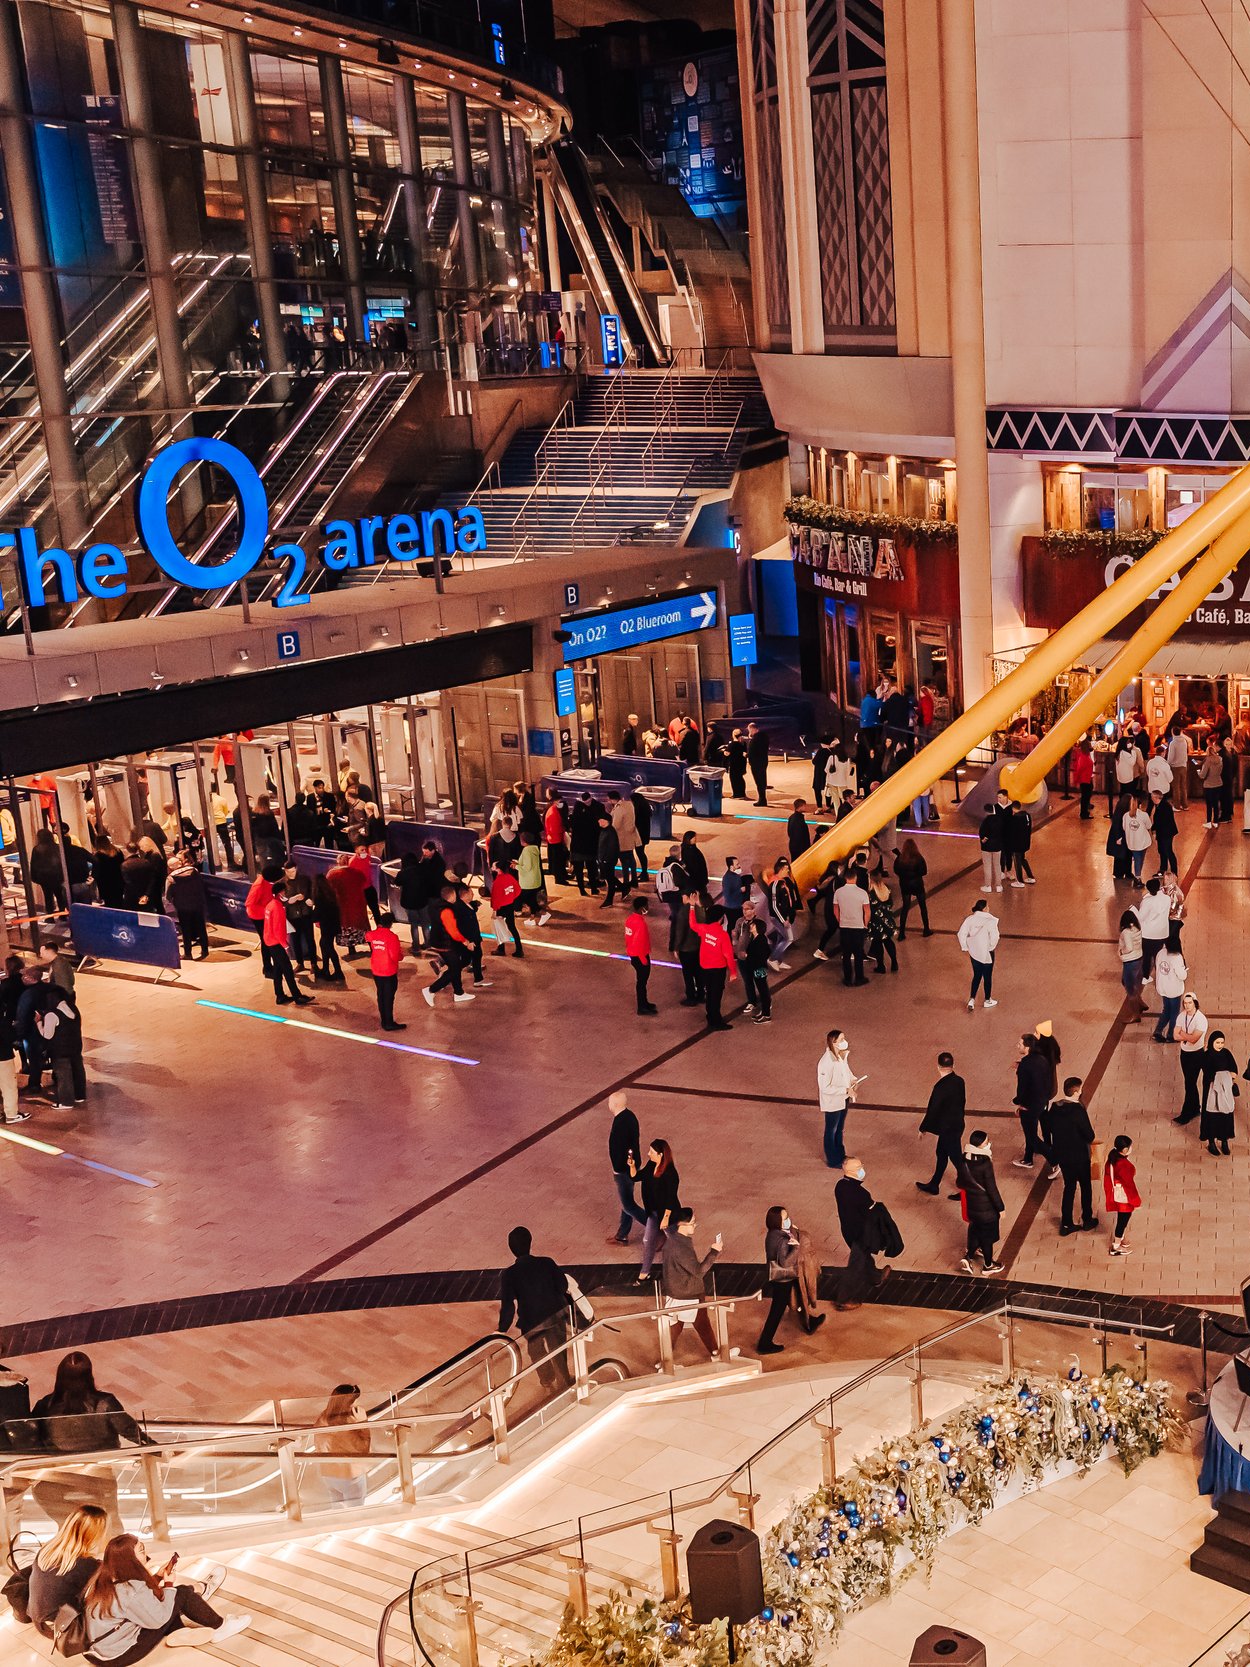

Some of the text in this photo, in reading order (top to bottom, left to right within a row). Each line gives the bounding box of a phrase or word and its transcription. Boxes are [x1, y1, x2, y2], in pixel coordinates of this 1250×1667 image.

[137, 436, 311, 609] O2
[321, 506, 487, 570] arena
[567, 586, 577, 604] B
[834, 578, 845, 592] Bar
[846, 580, 852, 594] &
[852, 581, 868, 597] Grill
[619, 611, 681, 635] O2 Blueroom
[1195, 607, 1230, 626] Café,
[282, 635, 296, 656] B
[568, 624, 607, 647] On O2?
